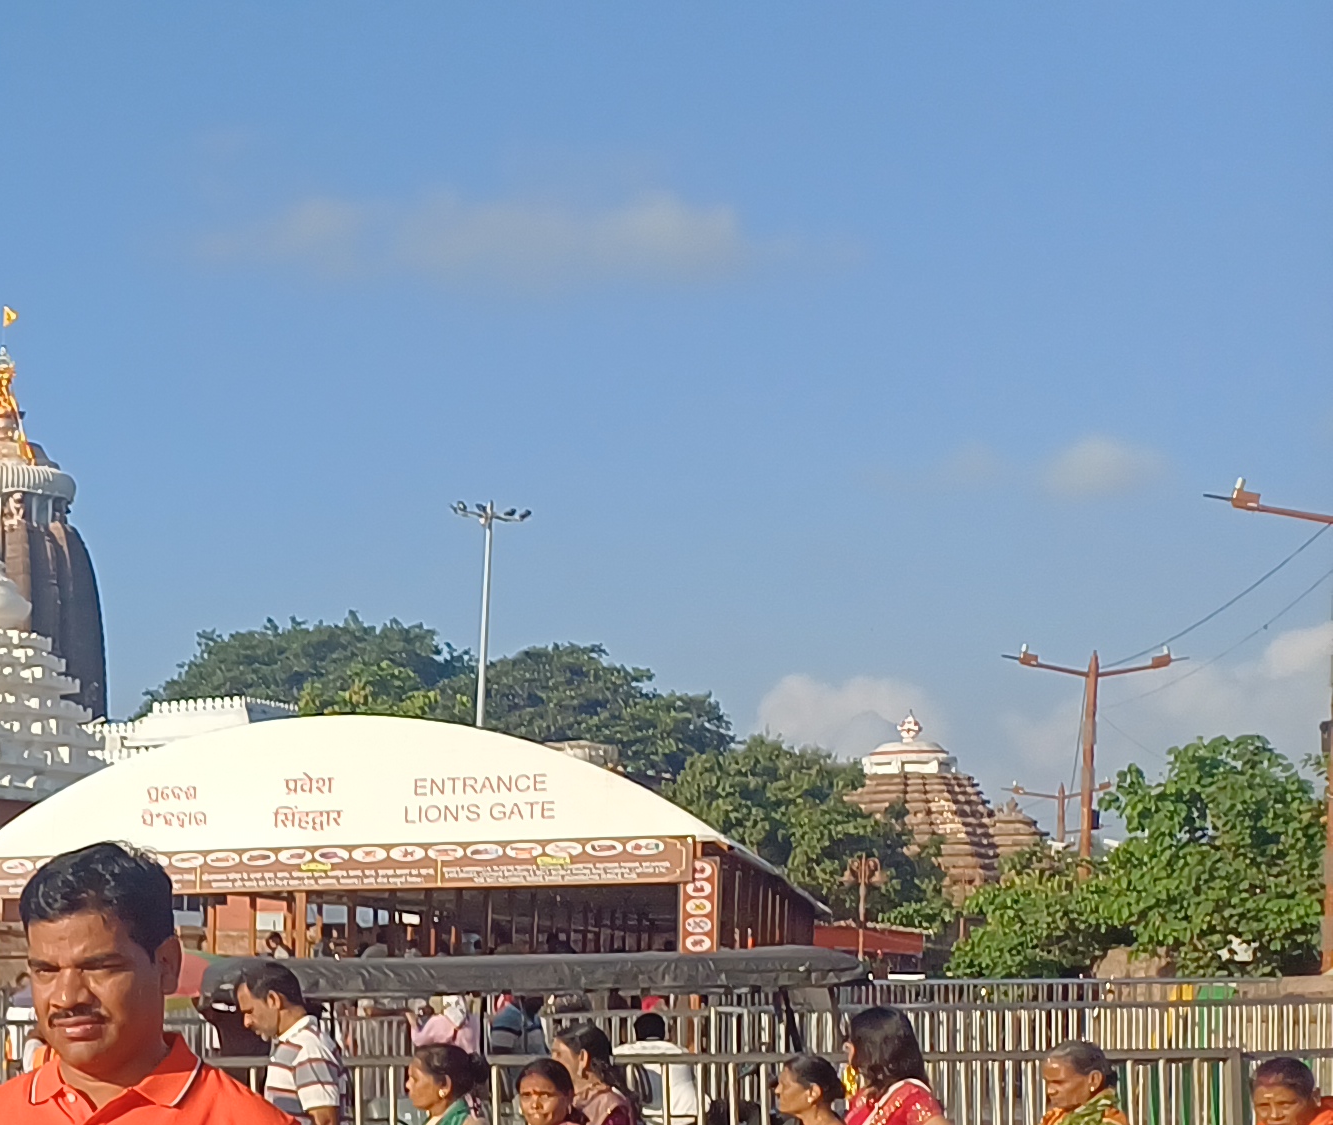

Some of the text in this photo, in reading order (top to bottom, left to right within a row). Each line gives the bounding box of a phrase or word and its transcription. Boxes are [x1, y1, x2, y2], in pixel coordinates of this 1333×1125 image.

[284, 772, 334, 796] प्रवेश
[414, 773, 548, 797] ENTRANCE
[273, 805, 344, 831] सिंहद्वार
[404, 801, 555, 824] LION'S GATE
